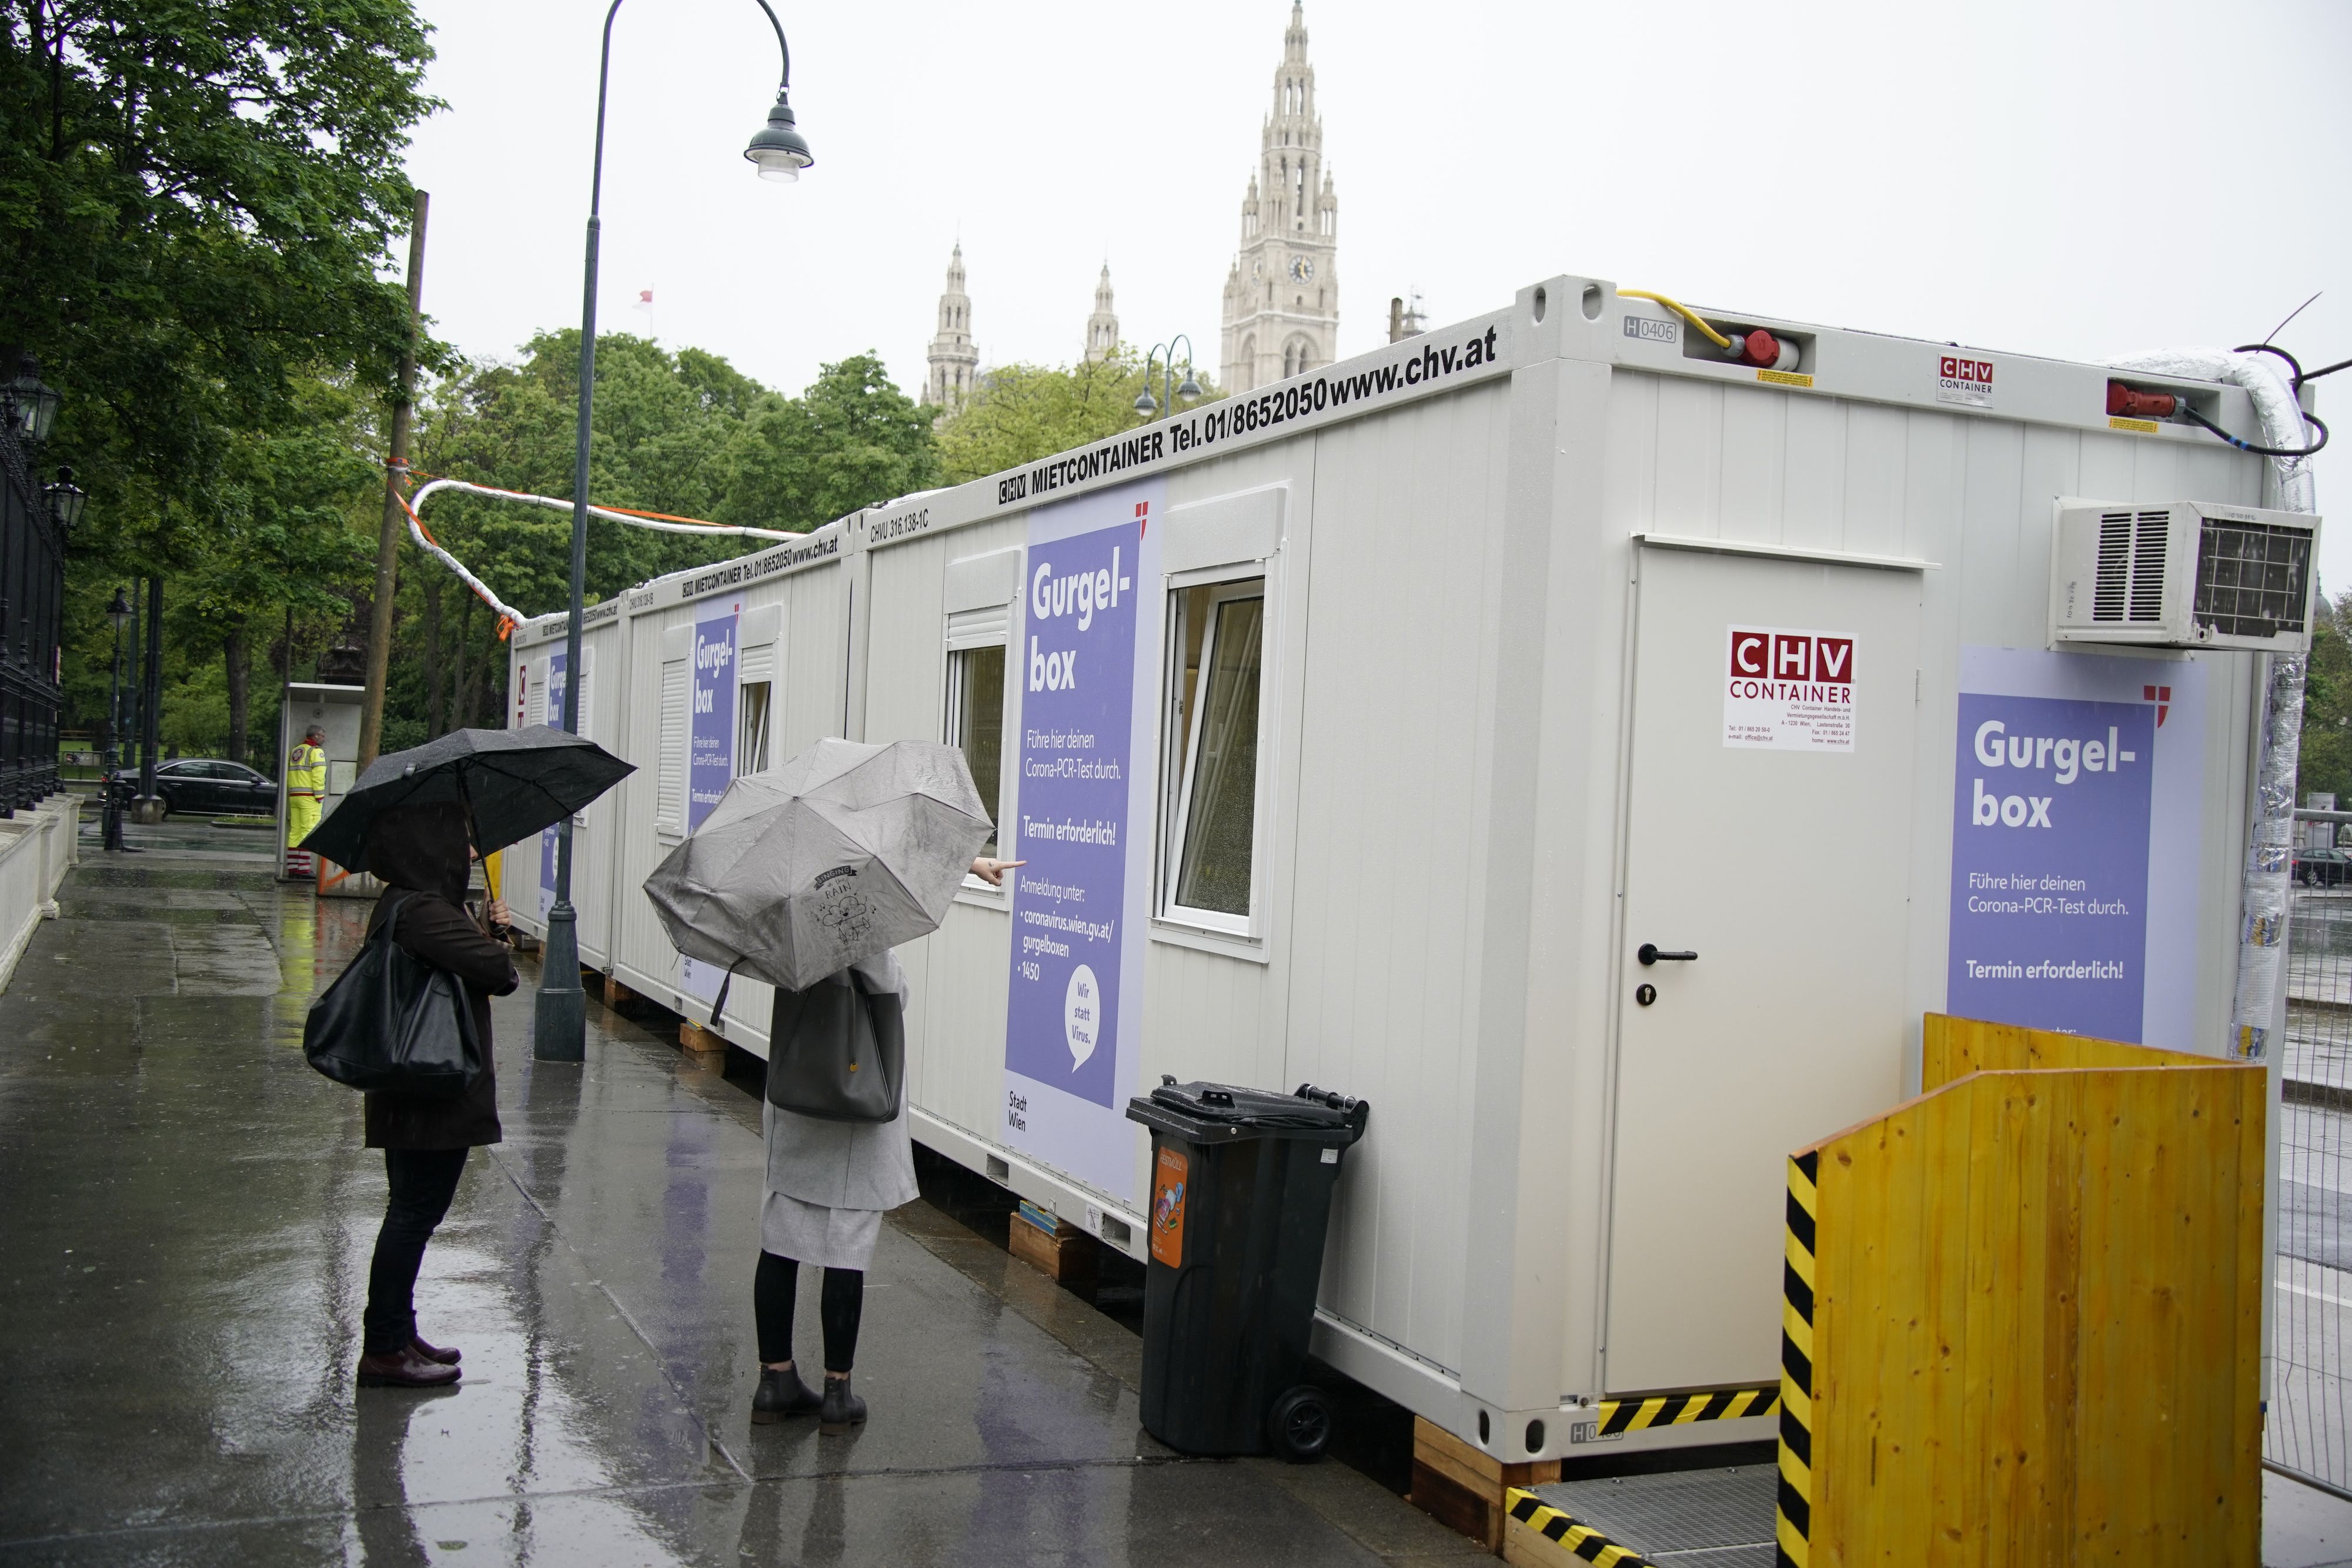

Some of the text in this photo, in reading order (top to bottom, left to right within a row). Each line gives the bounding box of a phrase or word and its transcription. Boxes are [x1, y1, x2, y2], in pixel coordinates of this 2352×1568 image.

[1942, 360, 1991, 380] CHV
[1940, 379, 1992, 394] CONTAINER
[999, 474, 1026, 505] CHV
[1032, 432, 1163, 495] MIETCONTAINER
[1170, 423, 1202, 454] Tel.
[871, 508, 928, 543] CHVU 316.138-1C
[695, 566, 741, 594] MIETCONTAINER
[744, 563, 754, 580] Tel.
[793, 533, 838, 565] www.chv.at
[1033, 546, 1130, 631] Gurgel-
[697, 628, 733, 678] Gurgel-
[1029, 636, 1077, 693] box
[1735, 636, 1850, 679] CHV
[695, 678, 713, 714] box
[1730, 680, 1850, 704] CONTAINER
[549, 696, 559, 722] box
[1027, 728, 1094, 750] Führe hier deinen
[1974, 720, 2136, 785] Gurgel-
[1025, 757, 1121, 780] Corona-PCR-Test durch.
[692, 788, 704, 803] Termin
[1972, 778, 2053, 828] box
[1024, 815, 1116, 847] Termin erforderlich!
[817, 867, 850, 883] SINGING
[1969, 872, 2086, 892] Führe hier deinen
[825, 881, 851, 900] RAIN
[1020, 875, 1085, 903] Anmeldung unter:
[1968, 895, 2129, 916] Corona-PCR-Test durch.
[1024, 911, 1114, 943] coronavirus.wien.gv.at/
[1023, 934, 1069, 958] gurgelboxen
[1022, 962, 1040, 982] 1450
[1966, 960, 2124, 979] Termin erforderlich!
[1077, 982, 1090, 999] Wir
[1074, 1006, 1090, 1022] statt
[1072, 1024, 1091, 1045] Virus.
[1008, 1090, 1027, 1113] Stadt
[1008, 1109, 1027, 1132] Wien
